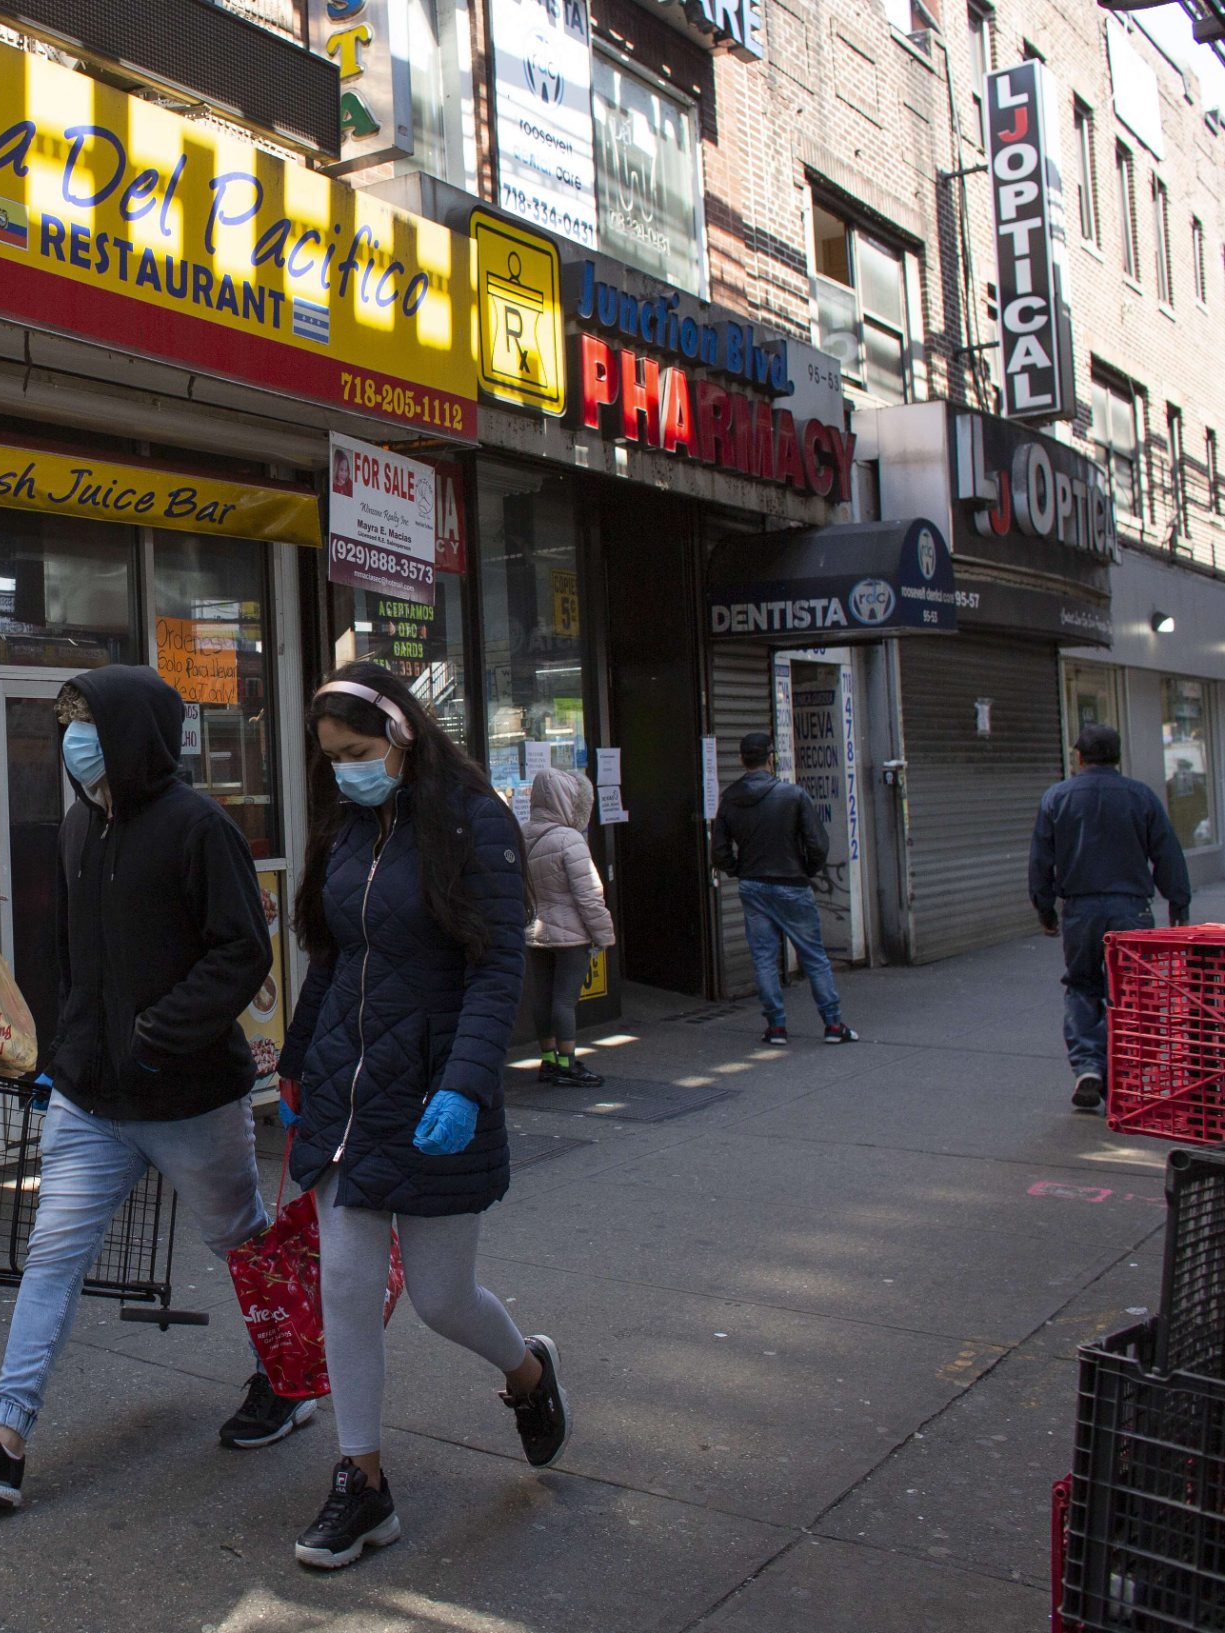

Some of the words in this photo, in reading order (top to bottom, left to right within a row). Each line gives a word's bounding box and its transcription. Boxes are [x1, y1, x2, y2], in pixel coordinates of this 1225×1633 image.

[62, 125, 188, 237] Del
[204, 171, 430, 318] Pacifico
[40, 212, 286, 330] RESTAURANT
[578, 259, 719, 367] Junction
[725, 319, 795, 398] Blvd.
[807, 362, 840, 392] 95-53
[340, 371, 463, 431] 718-205-1112
[580, 331, 858, 502] PHARMACY
[48, 468, 156, 514] Juice
[164, 487, 236, 526] Bar
[354, 451, 381, 491] FOR
[383, 462, 416, 503] SALE
[357, 518, 379, 534] Mayra
[379, 526, 387, 536] E.
[388, 528, 412, 544] Macias
[331, 538, 434, 585] (929)888-3573
[711, 598, 848, 634] DENTISTA
[954, 590, 980, 608] 95-57
[157, 649, 183, 673] Solo
[186, 657, 210, 679] Para
[793, 711, 834, 740] NUEVA
[795, 745, 839, 769] IRECCION
